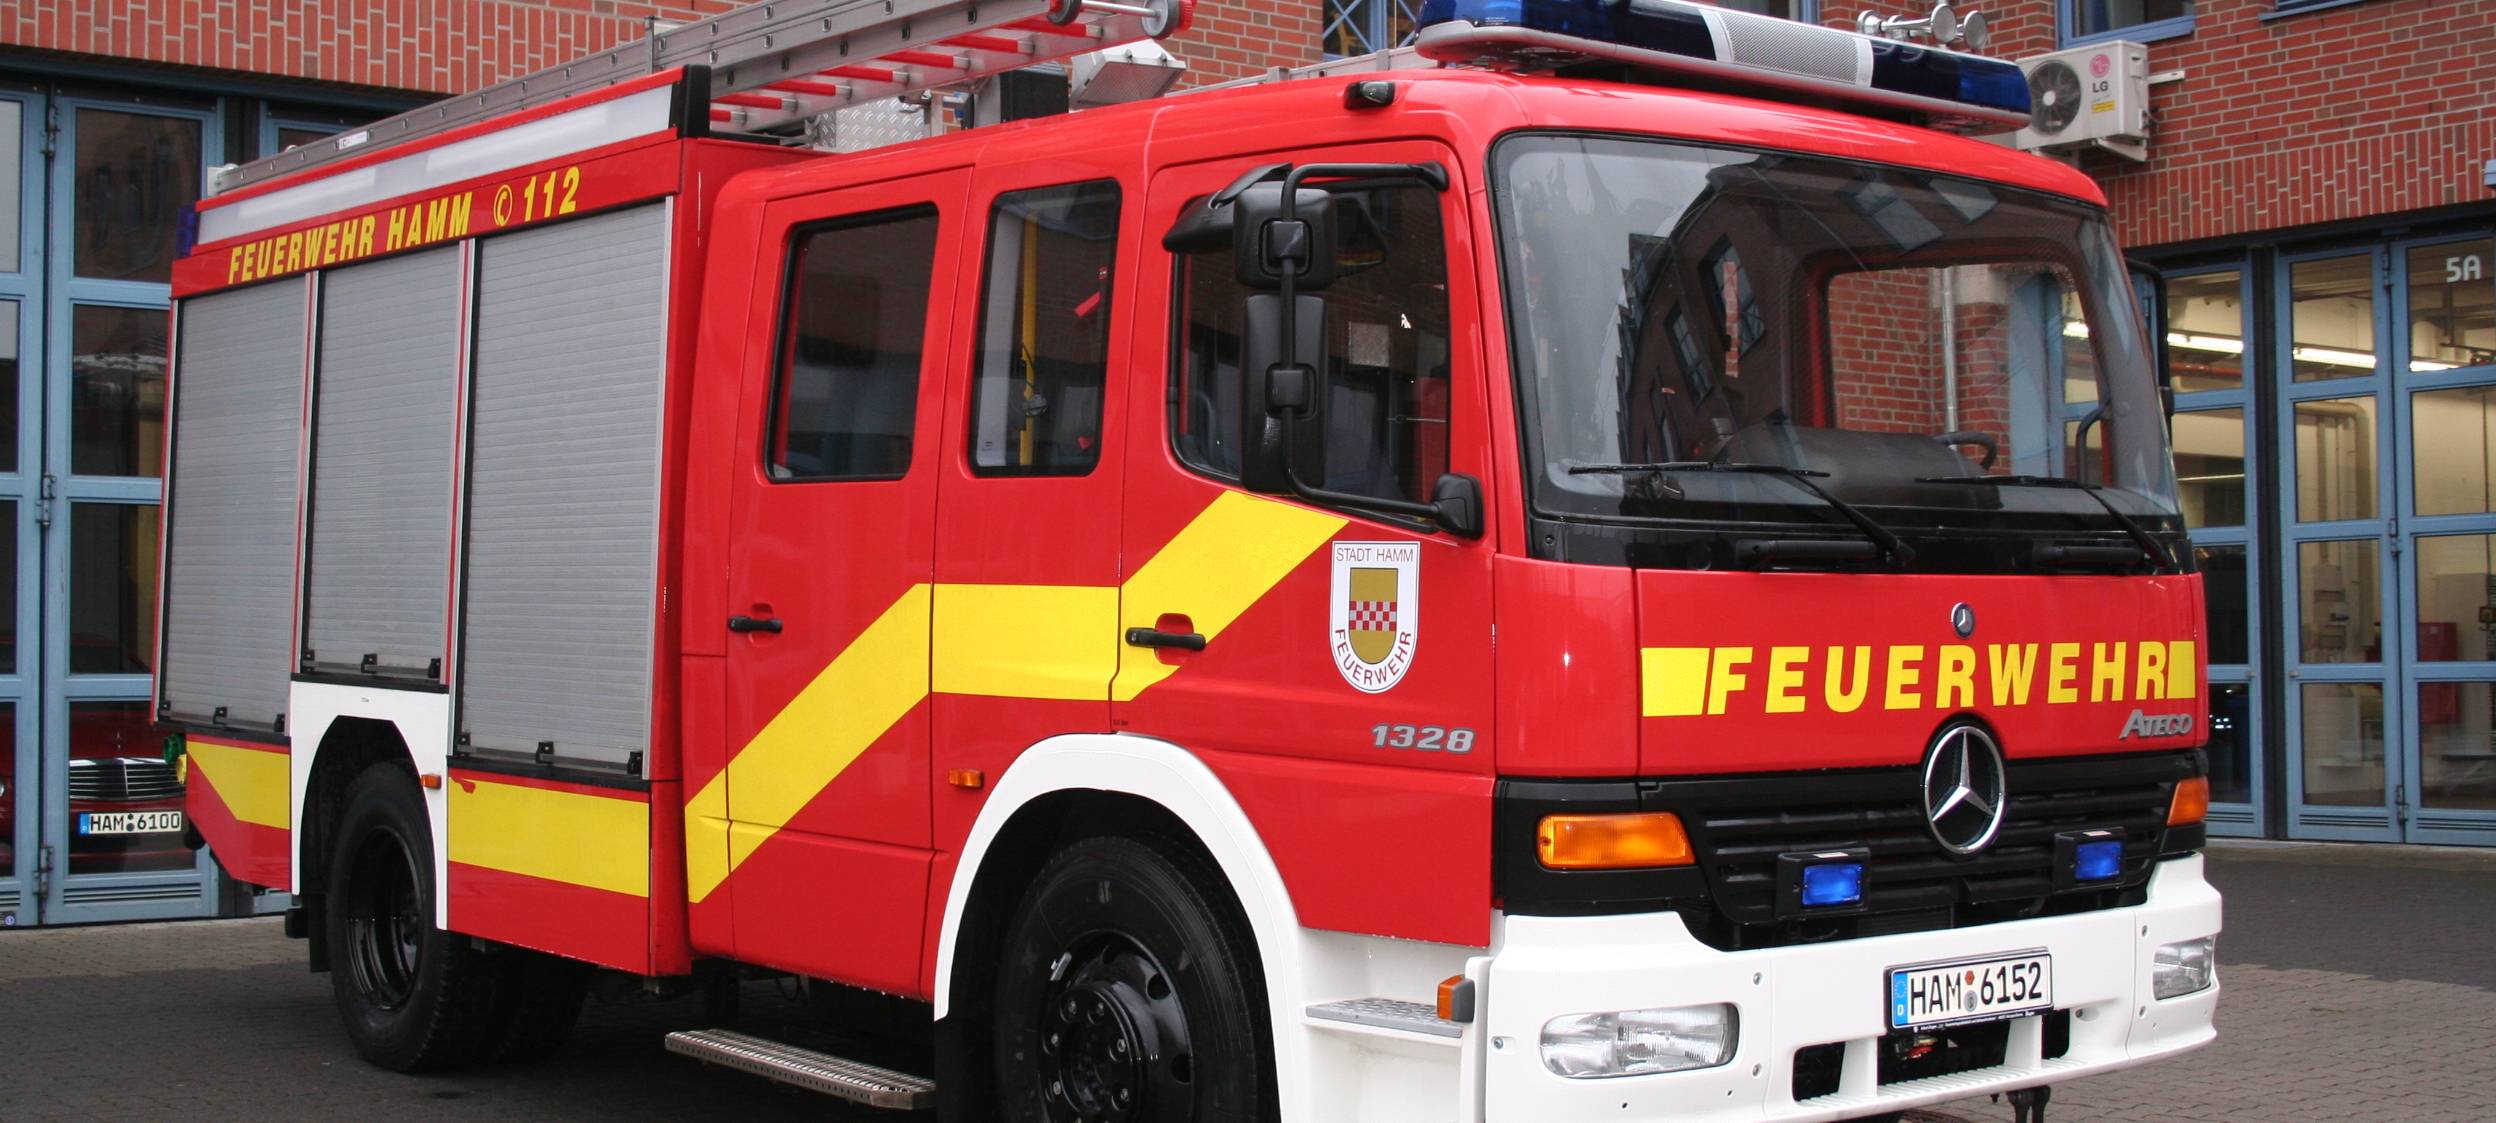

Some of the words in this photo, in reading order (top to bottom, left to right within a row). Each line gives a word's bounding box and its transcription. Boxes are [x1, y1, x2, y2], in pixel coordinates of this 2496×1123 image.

[2092, 80, 2109, 93] LG
[228, 215, 376, 285] FEUERWEHR
[386, 191, 473, 251] HAMM
[524, 166, 580, 222] 112
[2446, 255, 2481, 283] 5A
[1336, 547, 1372, 562] STADT
[1376, 548, 1413, 563] HAMM
[1335, 628, 1412, 686] FEUERWEHR
[1707, 641, 2167, 715] FEUERWEHR
[1372, 724, 1475, 754] 1328
[90, 814, 125, 832] HAM
[137, 812, 180, 831] 6100
[1910, 971, 1962, 1016] HAM
[1980, 961, 2042, 1005] 6152
